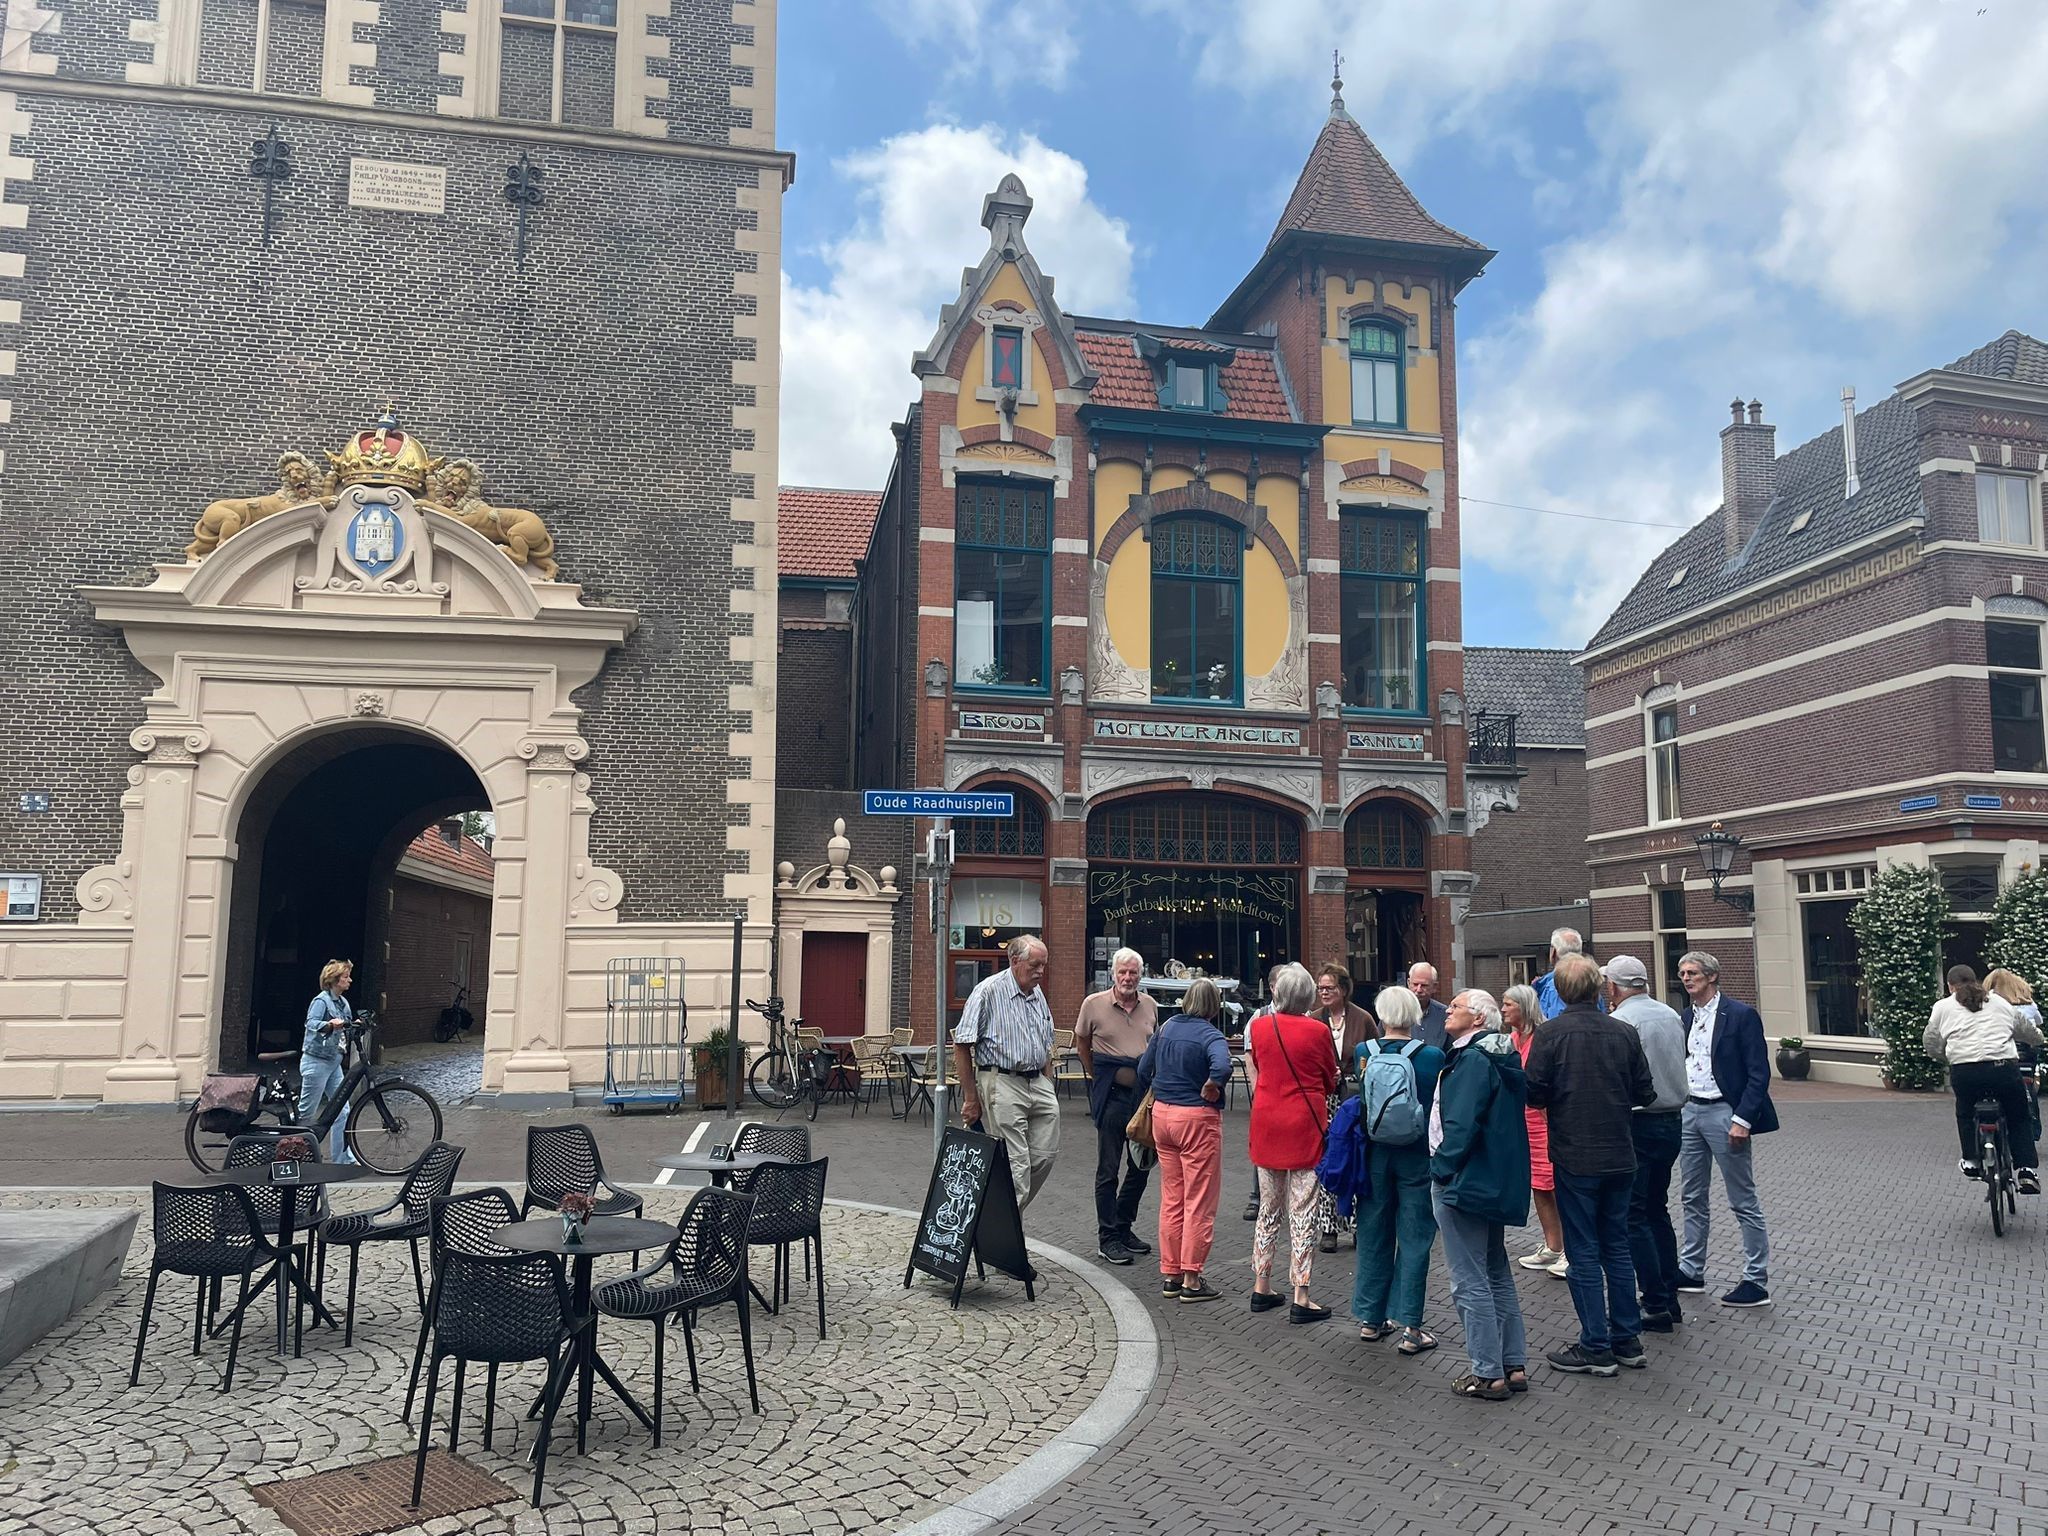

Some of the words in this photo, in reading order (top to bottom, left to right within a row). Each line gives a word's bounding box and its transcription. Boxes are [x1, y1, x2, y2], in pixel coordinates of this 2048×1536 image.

[963, 713, 1043, 731] BROOD
[1097, 721, 1297, 744] HOFLEVERANCIER
[1349, 734, 1421, 750] BANKET
[873, 796, 908, 808] Oude
[913, 796, 1006, 811] Raadhuisplein
[1103, 895, 1192, 922] Banketbakkerij
[1220, 897, 1285, 927] Konditorei
[944, 1143, 967, 1168] High
[279, 1165, 293, 1175] 21
